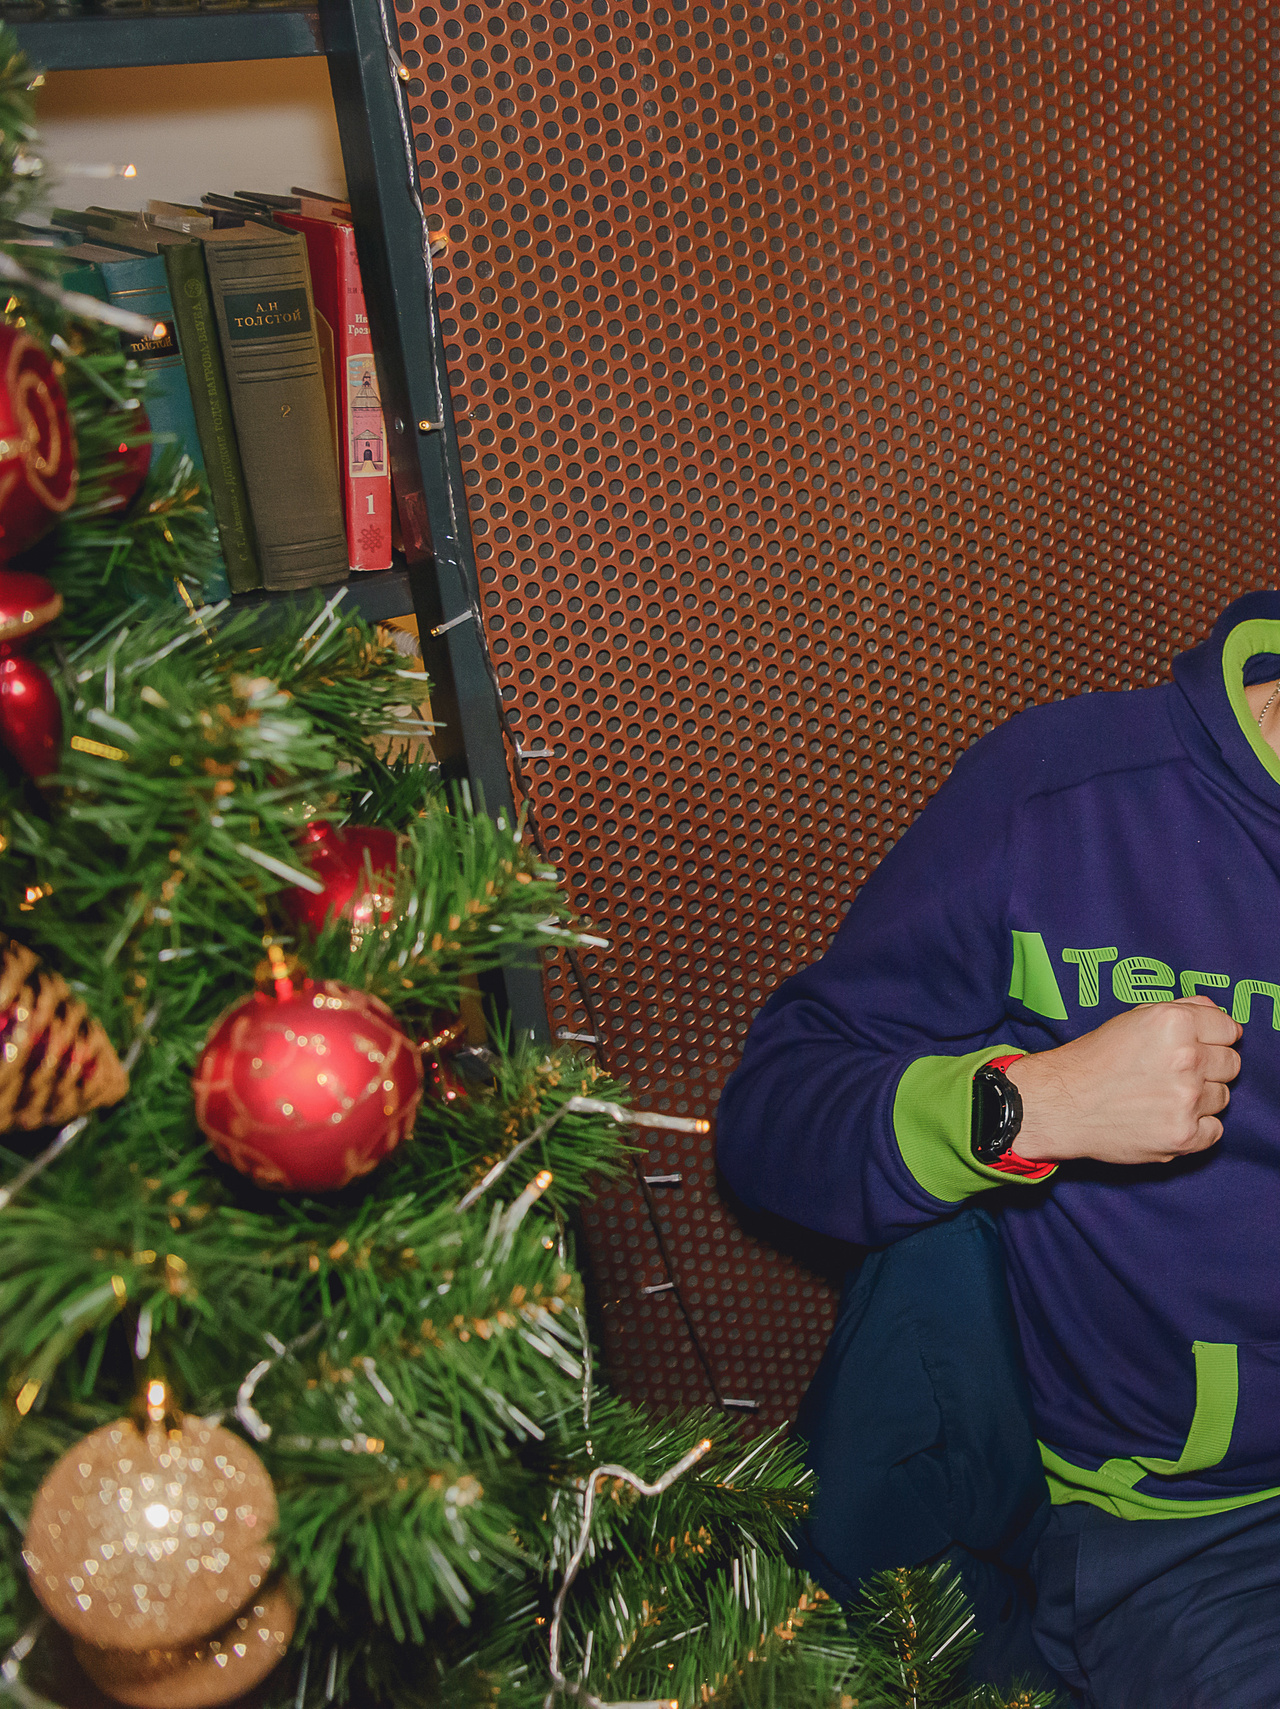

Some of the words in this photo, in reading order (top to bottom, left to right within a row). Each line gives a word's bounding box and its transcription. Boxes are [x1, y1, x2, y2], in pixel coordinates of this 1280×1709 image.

[234, 308, 303, 328] ТОЛСТОЙ
[354, 313, 368, 324] Ив
[347, 324, 370, 337] Гроз
[209, 399, 224, 431] ГОДЫ
[280, 404, 292, 418] 2
[216, 435, 237, 486] ДЕТСКИЕ
[365, 494, 376, 515] 1
